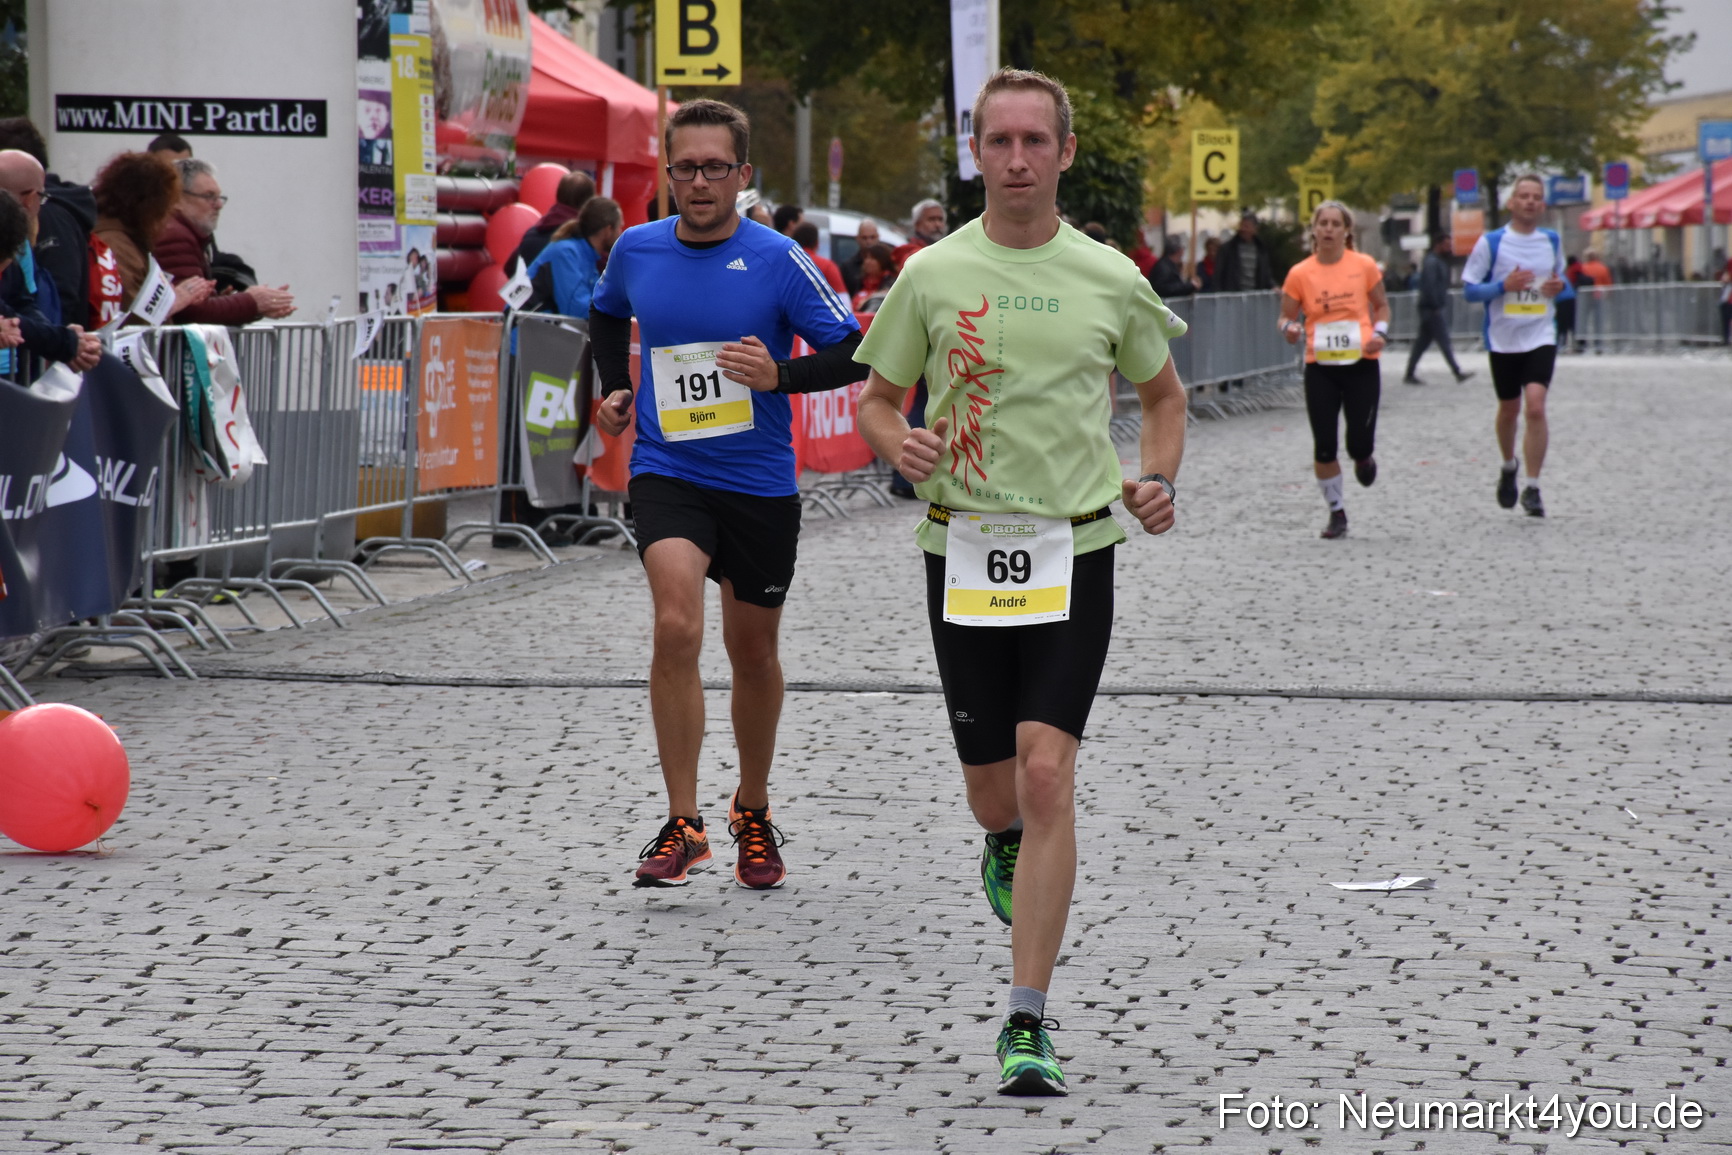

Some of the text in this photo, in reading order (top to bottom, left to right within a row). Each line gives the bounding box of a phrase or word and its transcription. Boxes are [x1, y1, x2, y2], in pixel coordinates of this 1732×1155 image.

[679, 0, 720, 56] B
[57, 101, 317, 133] www.MINI-Partl.de
[1197, 133, 1232, 146] Block
[1203, 151, 1226, 184] C
[997, 295, 1059, 313] 2006
[1325, 335, 1350, 348] 119
[681, 350, 716, 361] BOCK
[675, 369, 722, 403] 191
[689, 411, 716, 424] Björn
[976, 488, 1043, 505] SüdWest
[993, 524, 1036, 534] BOCK
[987, 549, 1031, 584] 69
[989, 595, 1027, 608] André
